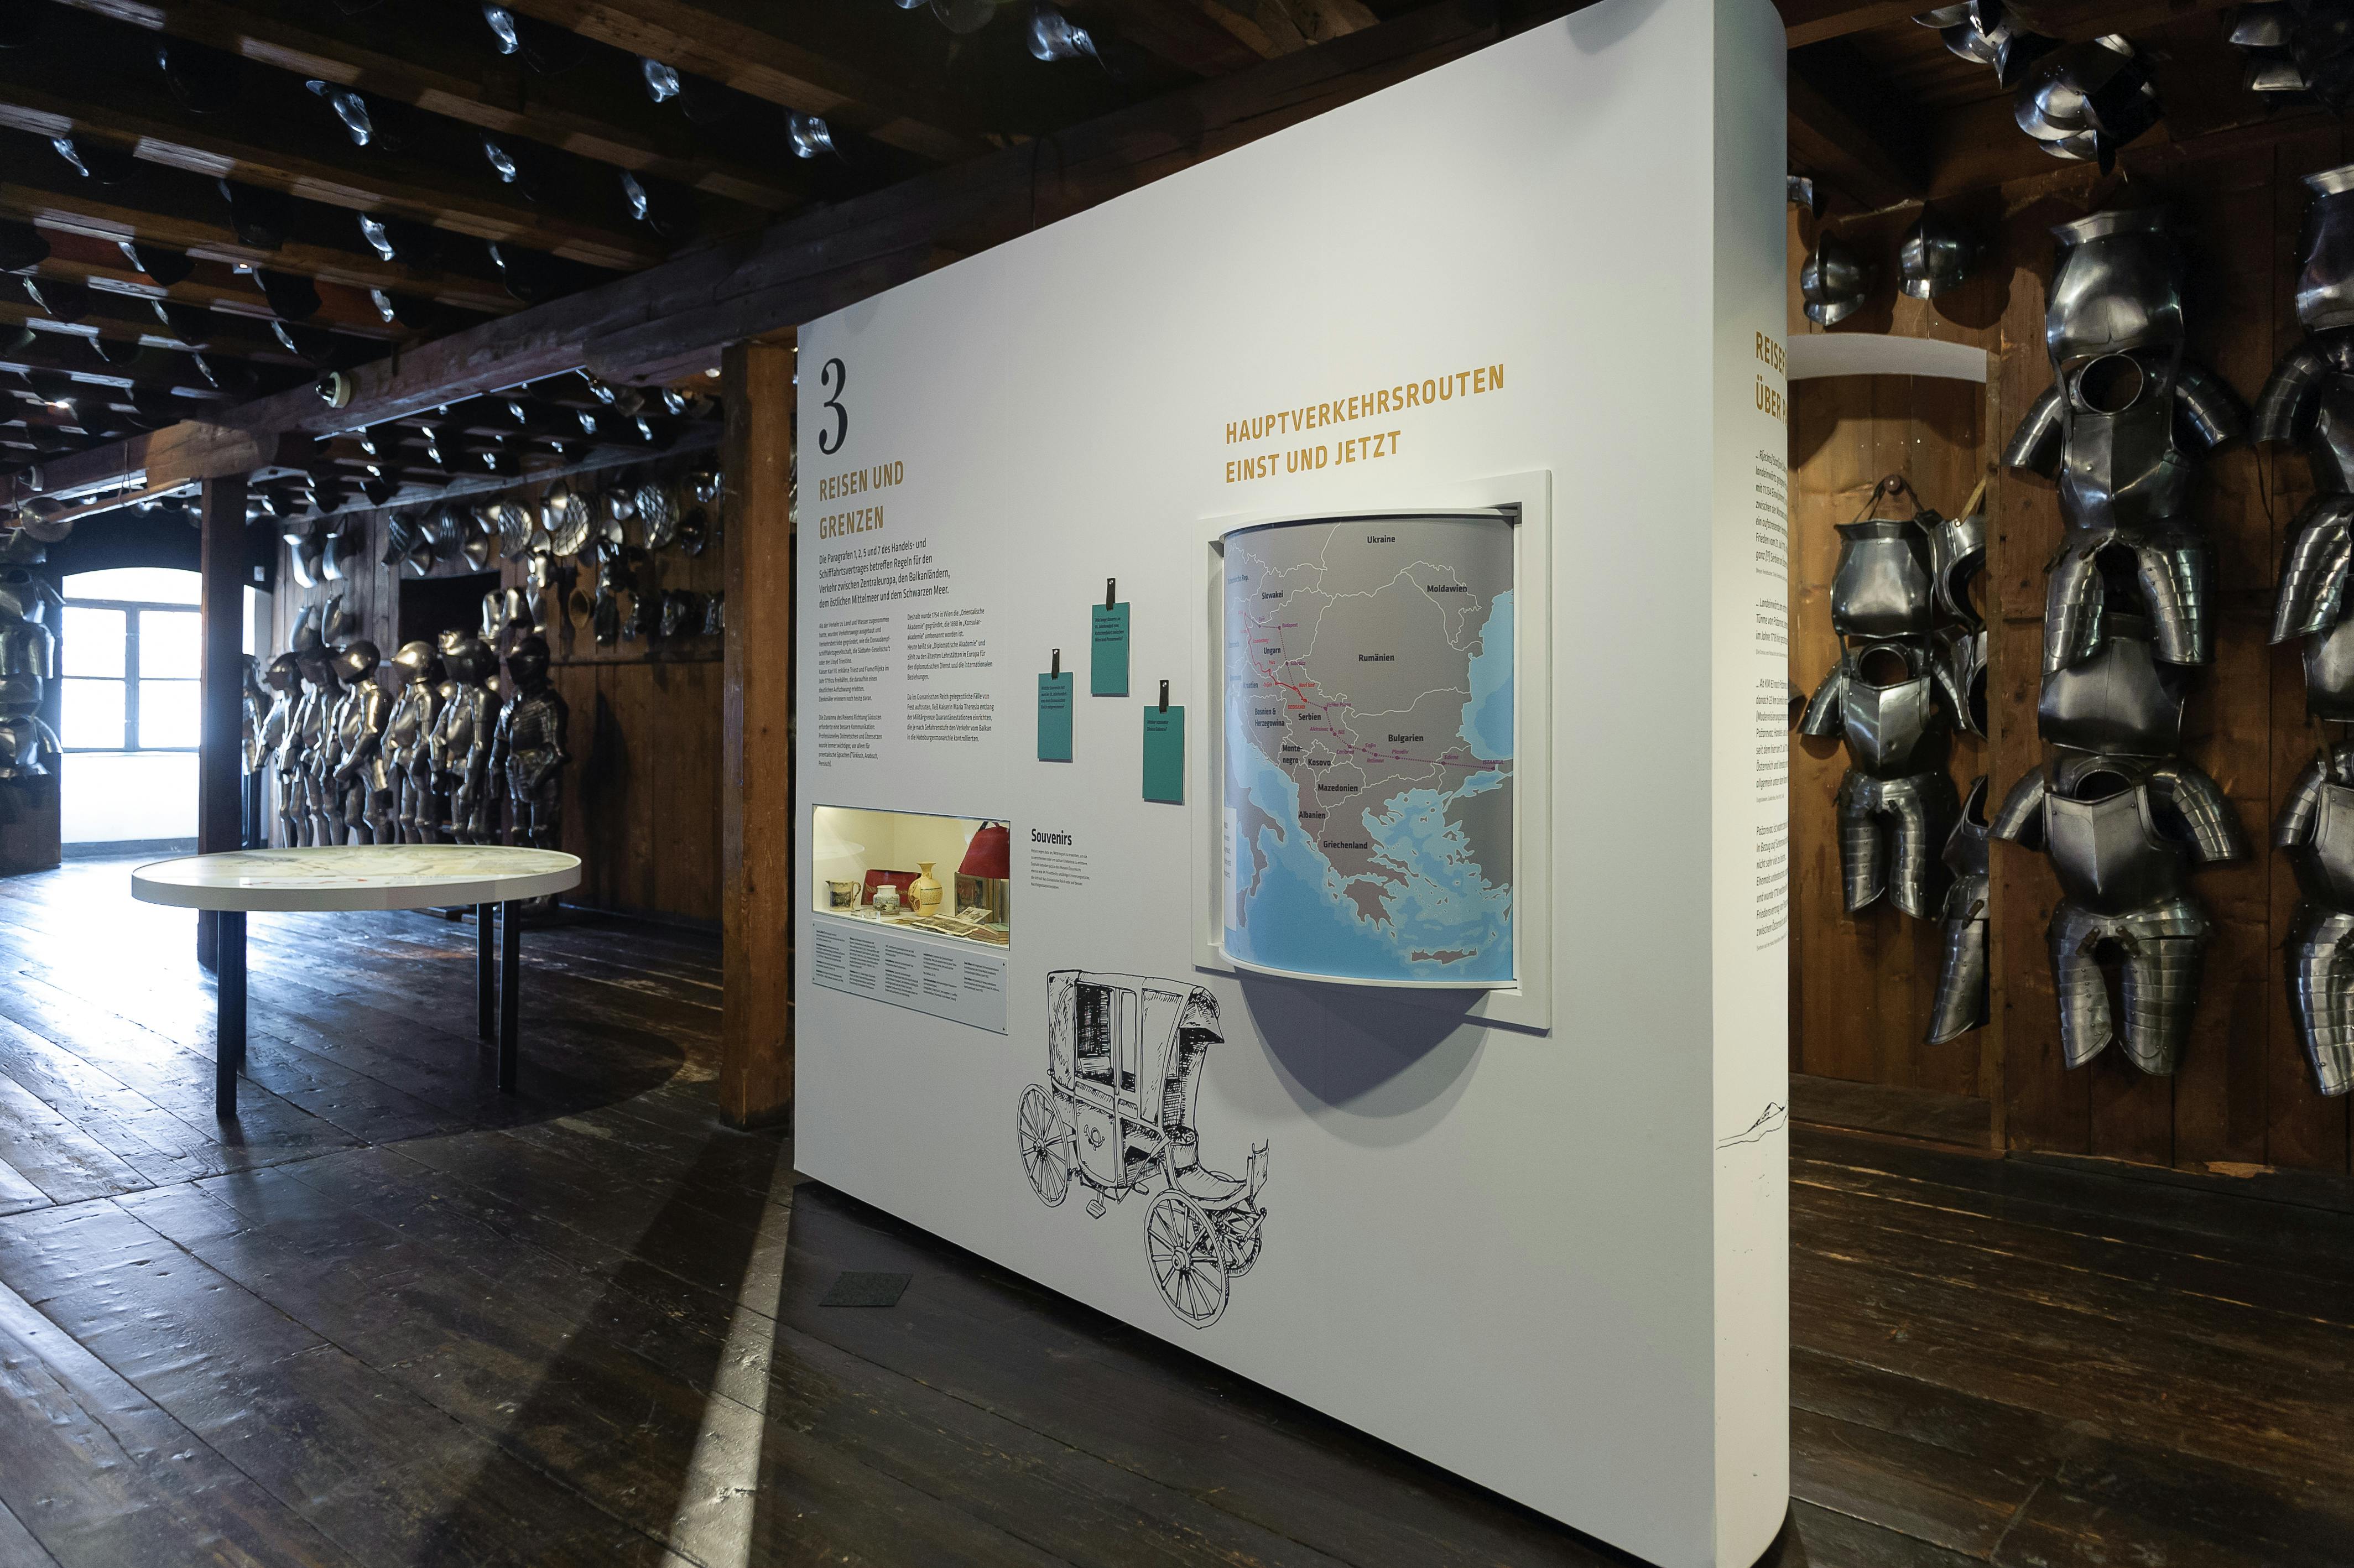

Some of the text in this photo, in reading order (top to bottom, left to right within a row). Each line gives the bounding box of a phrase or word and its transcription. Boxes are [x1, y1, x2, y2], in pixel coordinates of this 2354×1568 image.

[1226, 363, 1504, 444] HAUPTVERKEHRSROUTEN
[1756, 374, 1781, 421] ÜBER
[819, 358, 848, 455] 3
[1226, 430, 1401, 483] EINST UND JETZT
[820, 460, 904, 501] REISEN UND
[819, 506, 884, 540] GRENZEN
[1367, 535, 1395, 544] Ukraine
[827, 551, 853, 563] Paragrafen
[863, 548, 866, 558] 5
[867, 546, 877, 556] und
[878, 546, 880, 555] 7
[881, 545, 890, 554] des
[891, 541, 914, 553] Handels-
[916, 539, 926, 549] und
[869, 560, 893, 571] betreffen
[894, 557, 912, 569] Regeln
[922, 555, 932, 564] den
[819, 569, 950, 593] Verkehr zwischen Zentraleuropa, den Balkanländern,
[1262, 590, 1283, 600] Slowakei
[1426, 584, 1467, 593] Moldawien
[819, 586, 949, 608] dem östlichen Mittelmeer und dem Schwarzen Meer.
[1264, 647, 1281, 655] Ungarn
[1358, 653, 1394, 662] Rumänien
[1254, 719, 1285, 727] Herzegowina
[1388, 734, 1424, 743] Bulgarien
[1308, 758, 1331, 766] Kosovo
[1317, 783, 1358, 792] Mazedonien
[1299, 811, 1326, 820] Albanien
[1031, 828, 1072, 846] Souvenirs
[1323, 841, 1368, 850] Griechenland
